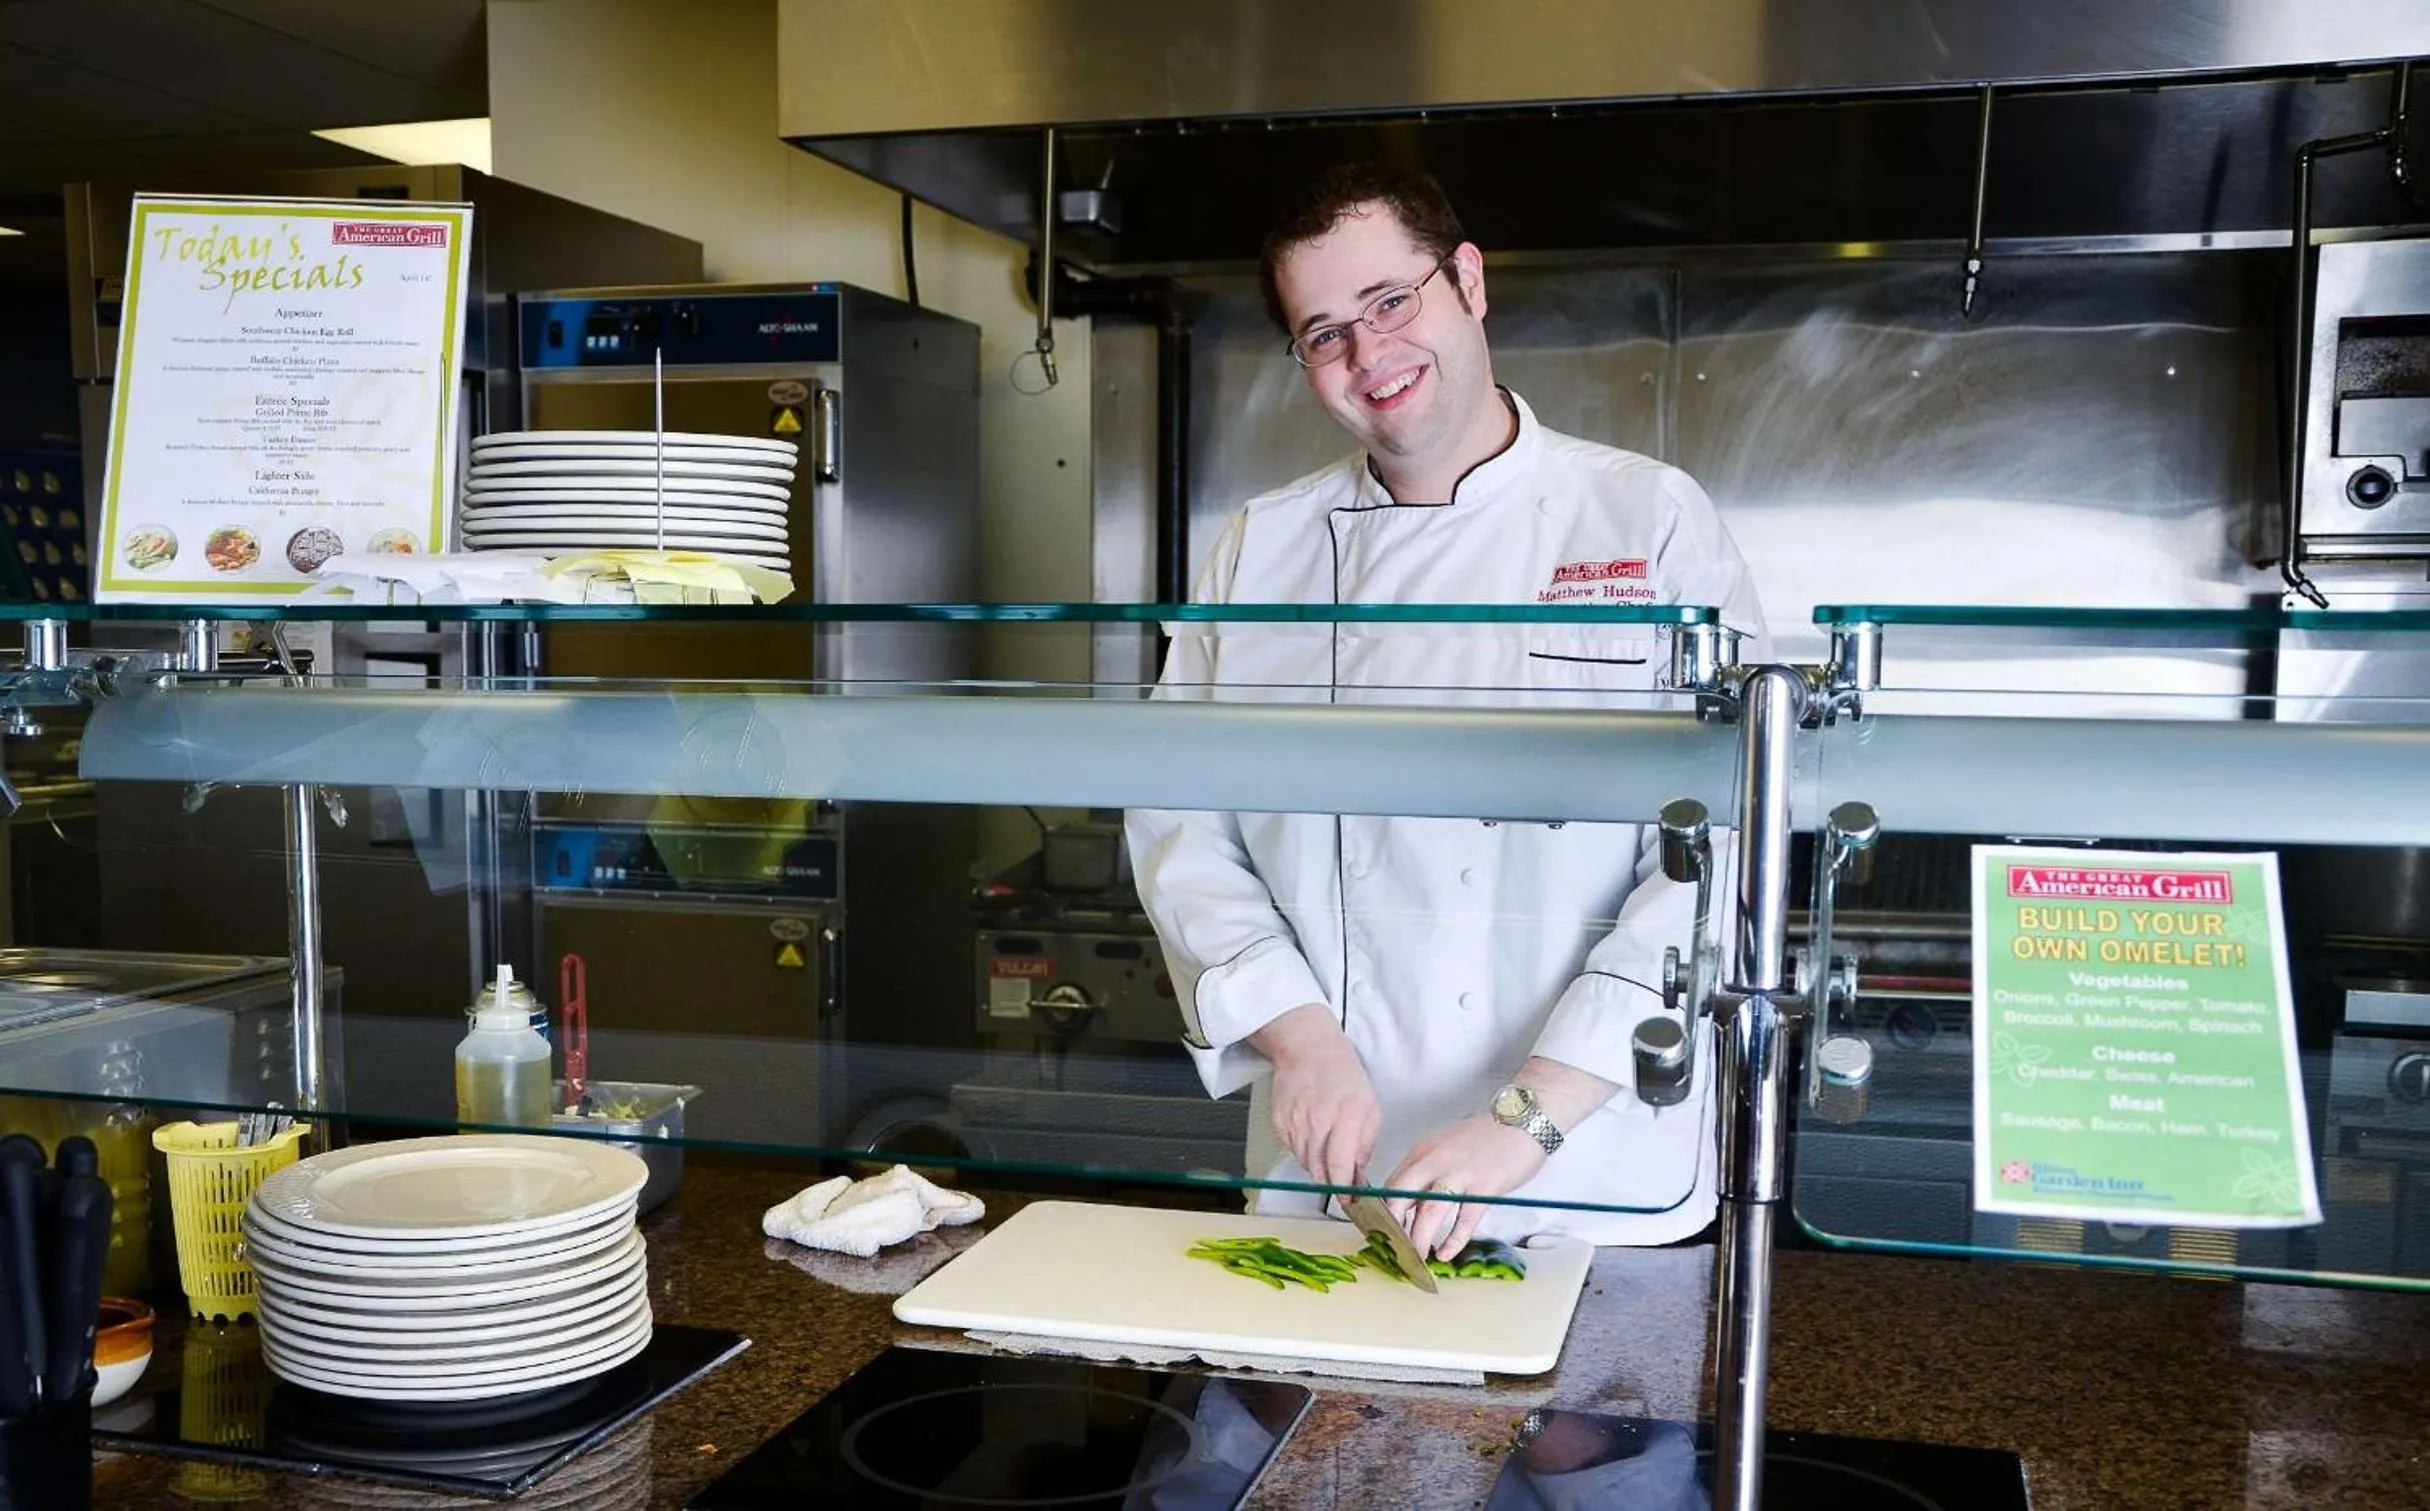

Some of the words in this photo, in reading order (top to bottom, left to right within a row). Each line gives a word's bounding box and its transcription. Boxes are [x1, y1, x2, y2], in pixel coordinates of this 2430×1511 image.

[155, 222, 303, 264] Today's
[339, 227, 405, 243] American
[406, 228, 442, 244] Grill
[199, 252, 364, 314] Specials
[275, 307, 323, 320] Appetizer
[320, 327, 335, 338] Egg
[337, 328, 354, 336] Roll
[255, 470, 291, 483] Lighter
[1555, 568, 1609, 580] American
[1610, 562, 1645, 577] Grill
[1537, 586, 1596, 602] Matthew
[1602, 586, 1657, 600] Hudson
[2016, 870, 2149, 898] American
[2152, 874, 2223, 900] Grill
[2047, 871, 2081, 883] THE
[2085, 872, 2144, 884] GREAT
[2018, 905, 2119, 934] BUILD
[2130, 909, 2227, 937] YOUR
[2012, 935, 2089, 961] OWN
[2099, 939, 2246, 968] OMELET!
[2068, 971, 2189, 991] Vegetables
[2064, 993, 2122, 1009] Green
[2084, 1013, 2184, 1034] Mushroom,
[2189, 1016, 2264, 1036] Spinach
[2091, 1045, 2176, 1065] Cheese
[2166, 1070, 2255, 1089] American
[2108, 1093, 2165, 1113] Meat
[2215, 1120, 2281, 1143] Turkey
